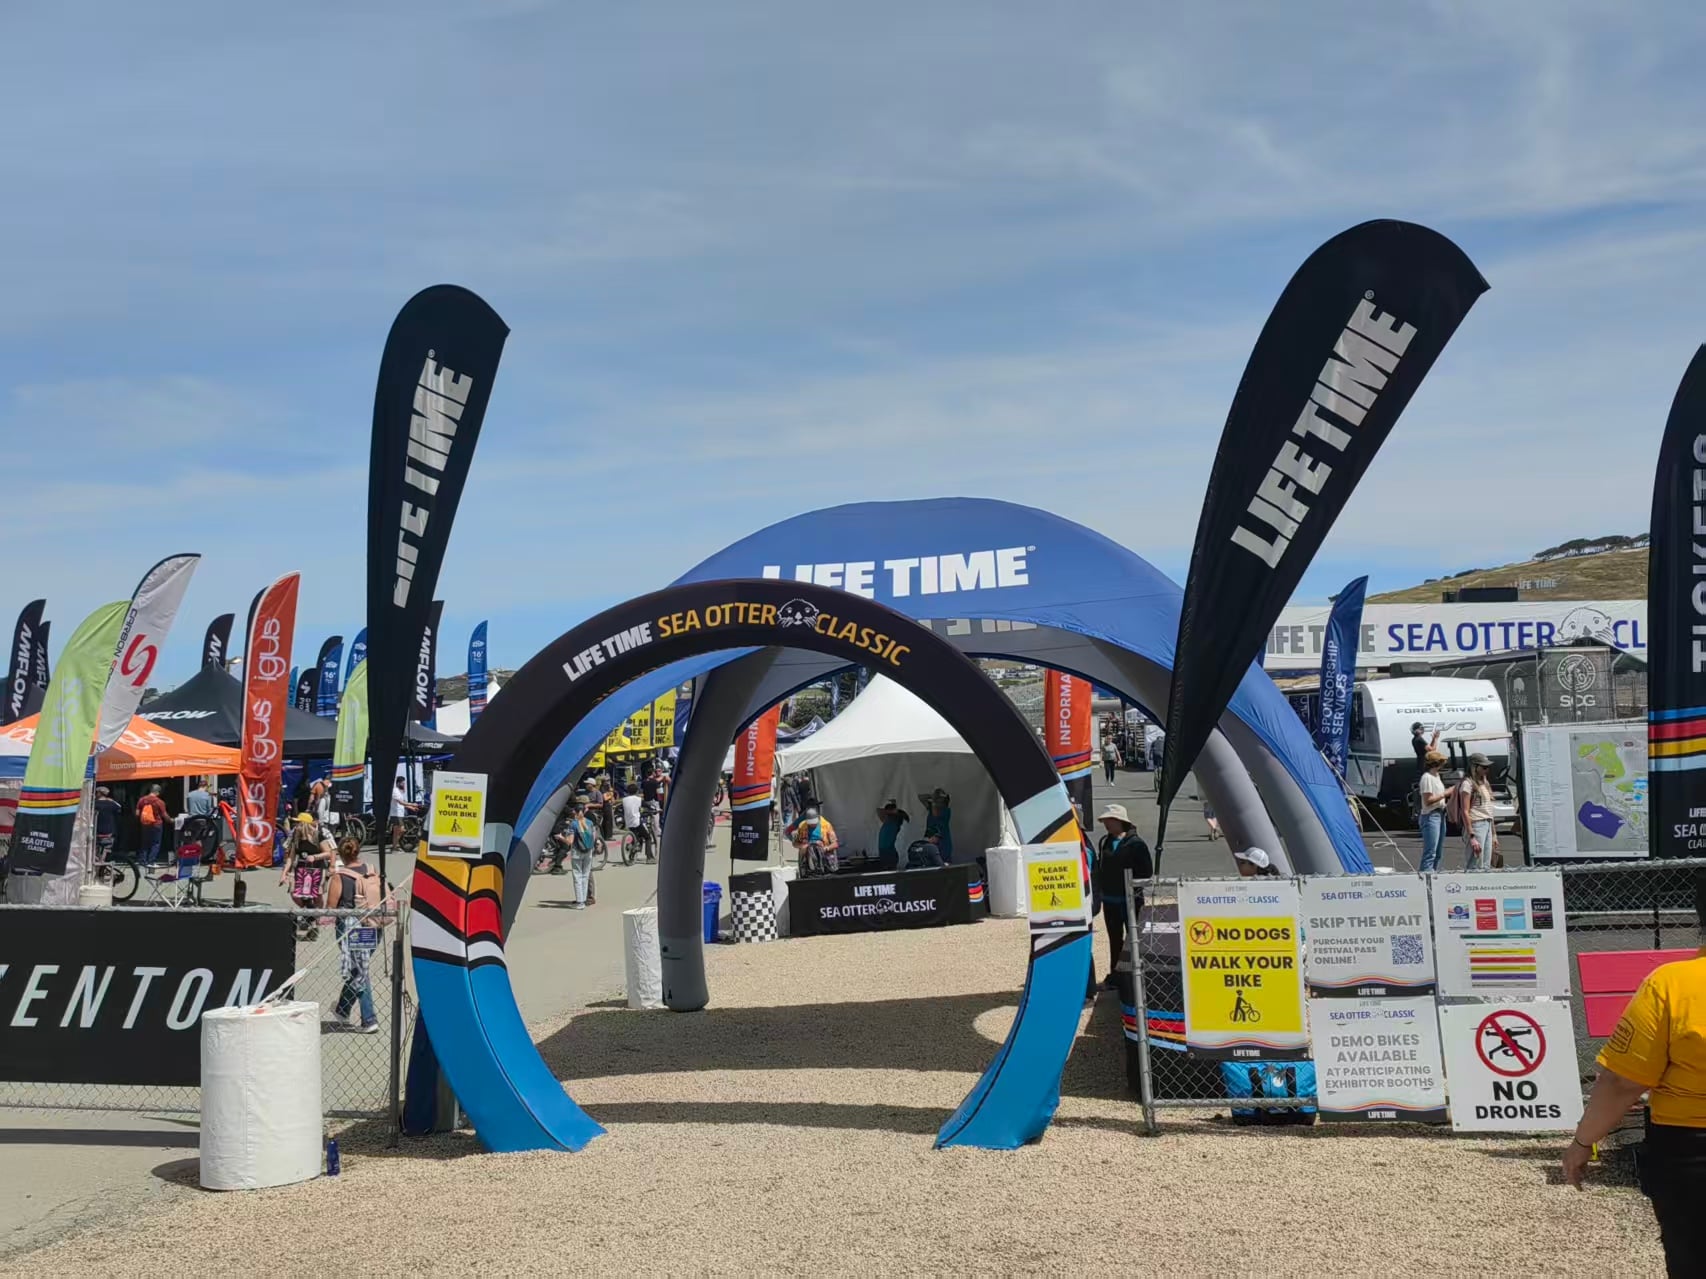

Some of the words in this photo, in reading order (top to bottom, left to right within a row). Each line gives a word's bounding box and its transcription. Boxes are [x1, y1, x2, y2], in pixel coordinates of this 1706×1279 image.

[1230, 440, 1332, 569] LIFE
[1292, 298, 1418, 452] TIME
[883, 546, 1030, 598] TIME
[113, 608, 138, 658] CARBON
[1387, 622, 1450, 652] SEA
[1455, 620, 1556, 651] OTTER
[562, 643, 606, 682] LIFE
[601, 621, 653, 658] TIME
[657, 608, 701, 639] SEA
[705, 602, 776, 628] OTTER
[814, 612, 911, 667] CLASSIC
[253, 618, 287, 682] igus
[11, 622, 32, 718] AMFLOW
[416, 626, 432, 708] AMFLOW
[1321, 640, 1338, 734] SPONSORSHIP
[1332, 673, 1348, 735] SERVICES
[248, 698, 278, 764] igus
[445, 794, 472, 802] PLEASE
[448, 802, 468, 810] WALK
[241, 783, 272, 846] igus
[1673, 824, 1697, 838] SEA
[21, 836, 34, 844] SEA
[35, 838, 55, 849] OTTER
[1038, 866, 1068, 874] PLEASE
[854, 886, 873, 898] LIFE
[874, 884, 896, 896] TIME
[1321, 892, 1337, 900] SEA
[1337, 891, 1363, 900] OTTER
[1375, 889, 1407, 898] CLASSIC
[1197, 896, 1212, 904] SEA
[1213, 896, 1237, 904] OTTER
[1249, 895, 1279, 904] CLASSIC
[820, 907, 841, 919] SEA
[842, 904, 876, 917] OTTER
[893, 899, 937, 914] CLASSIC
[1310, 916, 1345, 929] SKIP
[1347, 915, 1377, 928] THE
[1379, 914, 1422, 927] WAIT
[1217, 928, 1241, 940] NO
[1245, 928, 1290, 941] DOGS
[1313, 937, 1359, 945] PURCHASE
[1191, 957, 1240, 970] WALK
[1245, 956, 1293, 969] YOUR
[1314, 956, 1357, 965] ONLINE!
[1224, 974, 1262, 987] BIKE
[0, 964, 273, 1031] ENTON
[1358, 987, 1371, 996] LIFE
[1371, 987, 1386, 995] TIME
[1329, 1012, 1345, 1020] SEA
[1346, 1011, 1371, 1019] OTTER
[1384, 1010, 1415, 1018] CLASSIC
[1331, 1035, 1374, 1047] DEMO
[1377, 1034, 1419, 1046] BIKES
[1233, 1049, 1246, 1057] LIFE
[1246, 1049, 1261, 1057] TIME
[1337, 1050, 1417, 1063] AVAILABLE
[1326, 1067, 1342, 1076] AT
[1345, 1065, 1431, 1076] PARTICIPATING
[1325, 1078, 1385, 1089] EXHIBITOR
[1387, 1078, 1434, 1088] BOOTHS
[1493, 1080, 1538, 1101] NO
[1368, 1111, 1381, 1119] LIFE
[1475, 1104, 1562, 1119] DRONES
